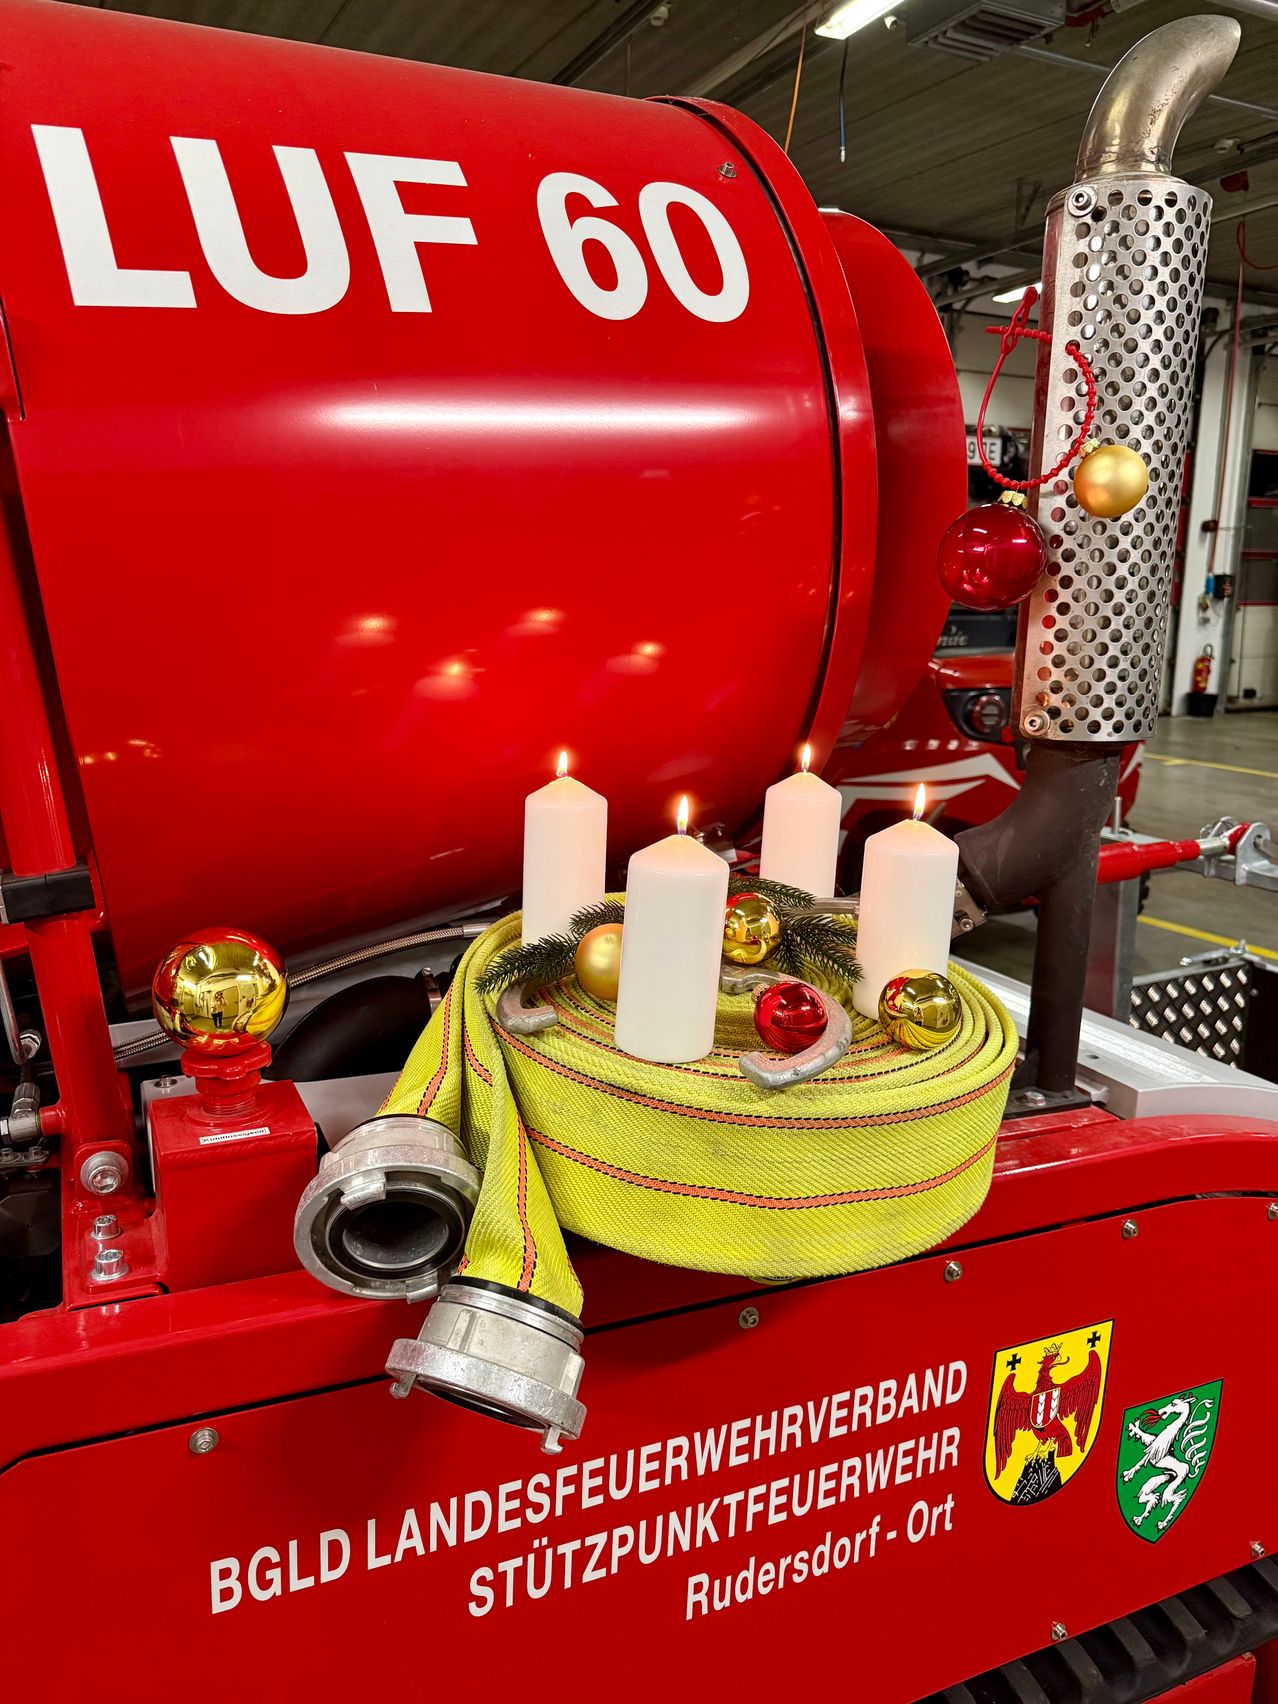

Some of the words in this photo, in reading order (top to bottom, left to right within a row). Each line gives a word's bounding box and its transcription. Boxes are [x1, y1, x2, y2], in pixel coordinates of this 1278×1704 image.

[31, 124, 478, 314] LUF
[537, 172, 749, 322] 60
[210, 1529, 351, 1615] BGLD
[367, 1361, 968, 1571] LANDESFEUERWEHRVERBAND
[468, 1427, 961, 1617] STÜTZPUNKTFEUERWEHR
[685, 1515, 881, 1621] Rudersdorf
[906, 1494, 955, 1543] Ort
